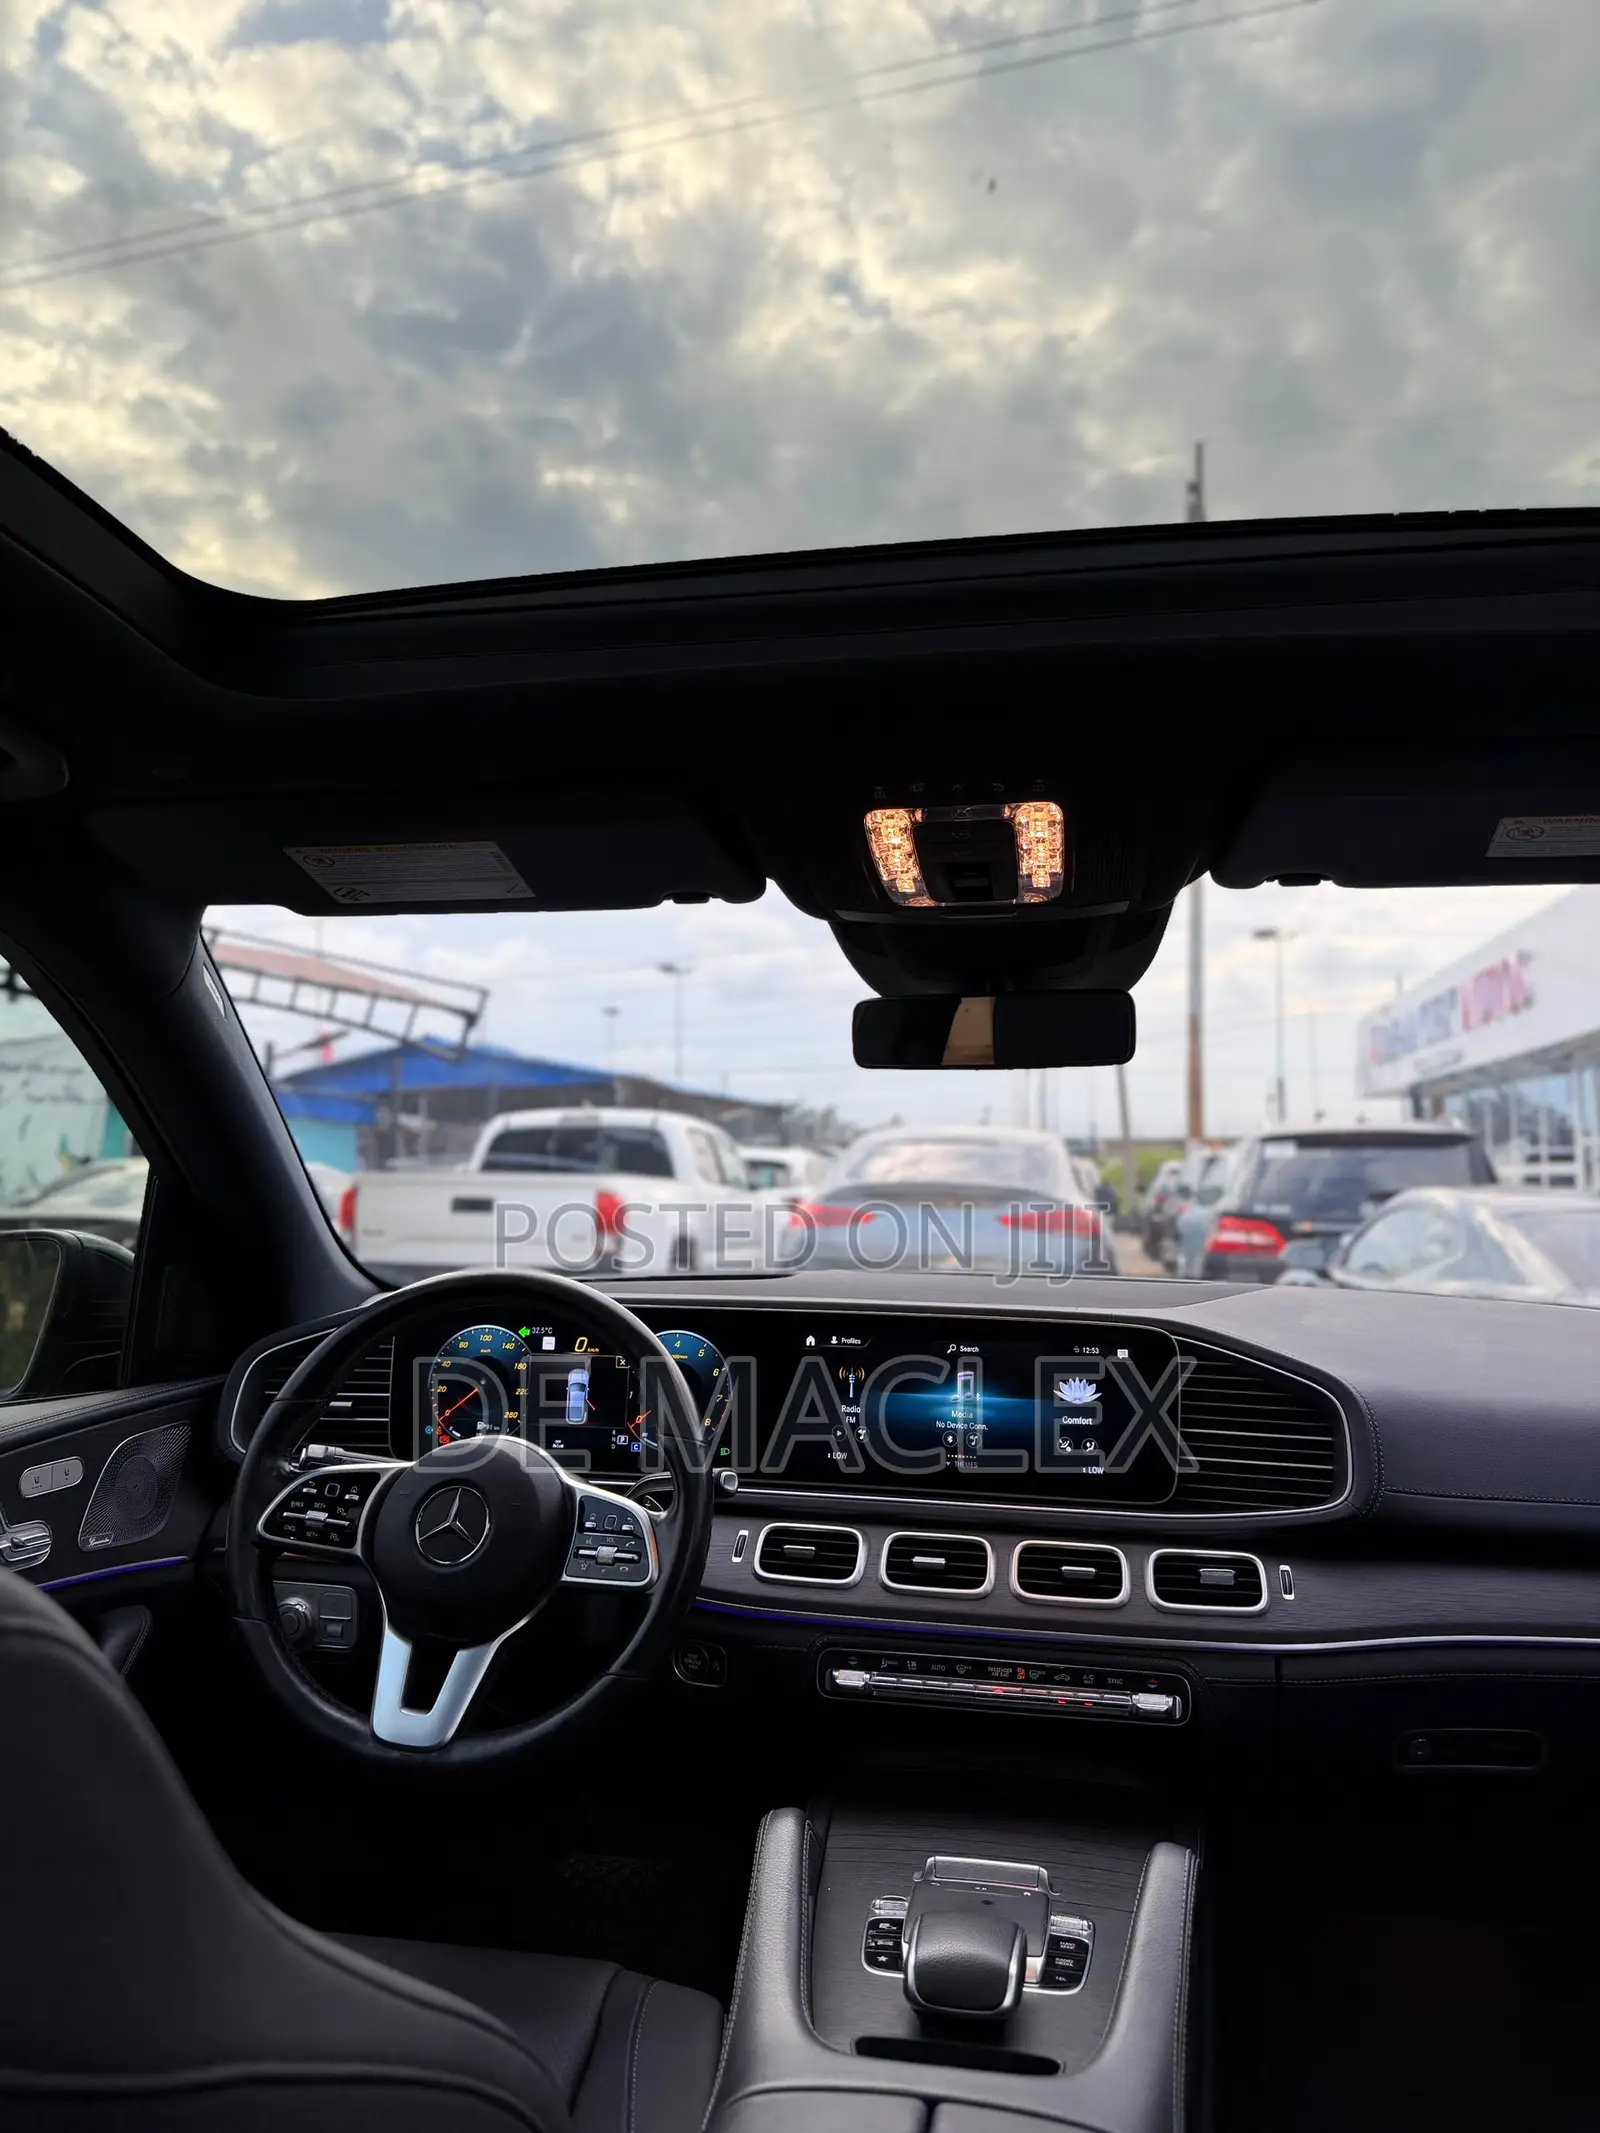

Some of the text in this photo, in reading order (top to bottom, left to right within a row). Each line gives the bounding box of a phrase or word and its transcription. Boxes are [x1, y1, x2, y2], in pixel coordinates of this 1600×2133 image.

[479, 1334, 493, 1342] 100
[841, 1336, 862, 1345] Profiles
[458, 1341, 469, 1349] 60
[501, 1342, 515, 1350] 140
[574, 1336, 589, 1353] 0
[673, 1340, 681, 1348] 4
[697, 1348, 705, 1357] 5
[959, 1345, 980, 1354] Search
[1082, 1346, 1100, 1355] 12:53
[441, 1360, 452, 1368] 40
[712, 1367, 720, 1377] 6
[436, 1385, 447, 1393] 20
[716, 1394, 724, 1403] 7
[841, 1404, 861, 1413] Radio
[951, 1409, 974, 1419] Media
[845, 1415, 856, 1424] FM
[1061, 1415, 1093, 1425] Comfort
[935, 1420, 989, 1431] No Device Conn.
[832, 1451, 848, 1460] LOW
[954, 1460, 978, 1469] THEMES
[1088, 1466, 1104, 1475] LOW
